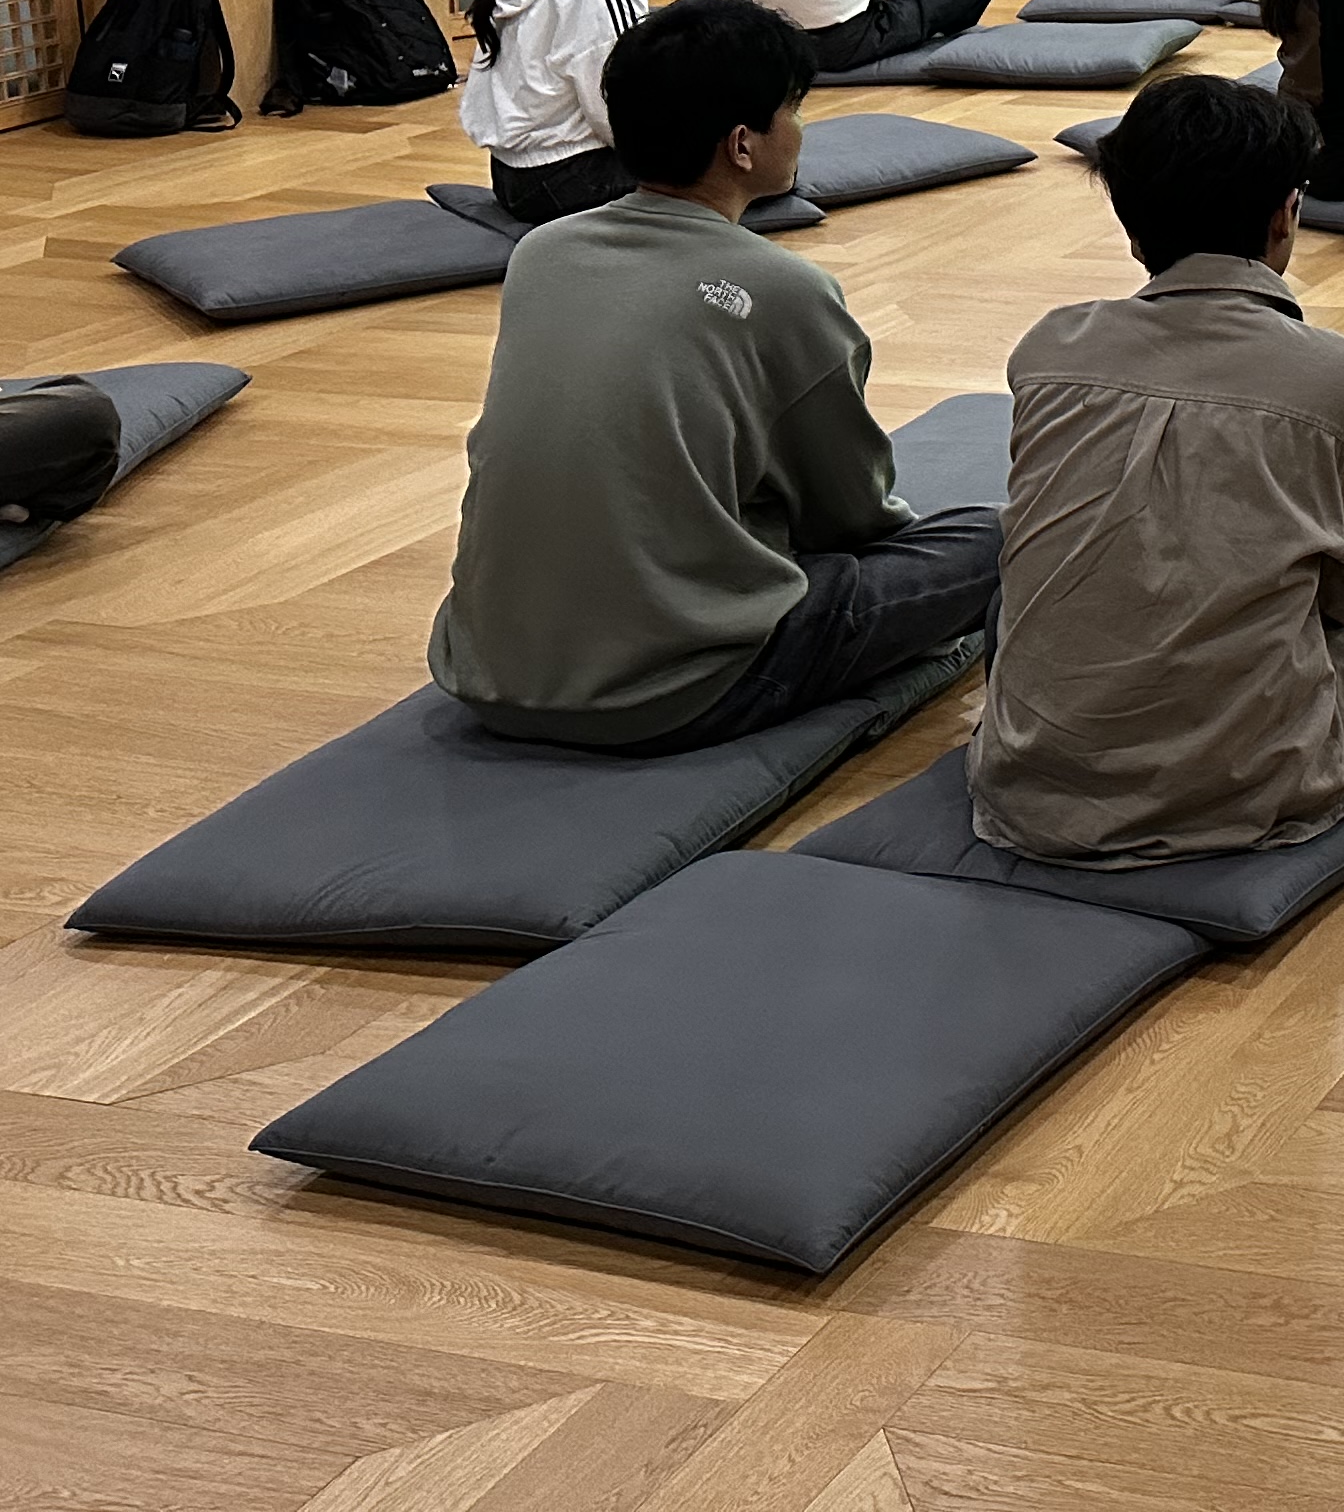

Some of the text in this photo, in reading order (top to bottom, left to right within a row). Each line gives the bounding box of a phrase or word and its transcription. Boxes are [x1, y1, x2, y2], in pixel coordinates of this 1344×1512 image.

[698, 282, 736, 301] NORTH
[720, 279, 740, 294] THE
[704, 293, 730, 310] FACE
